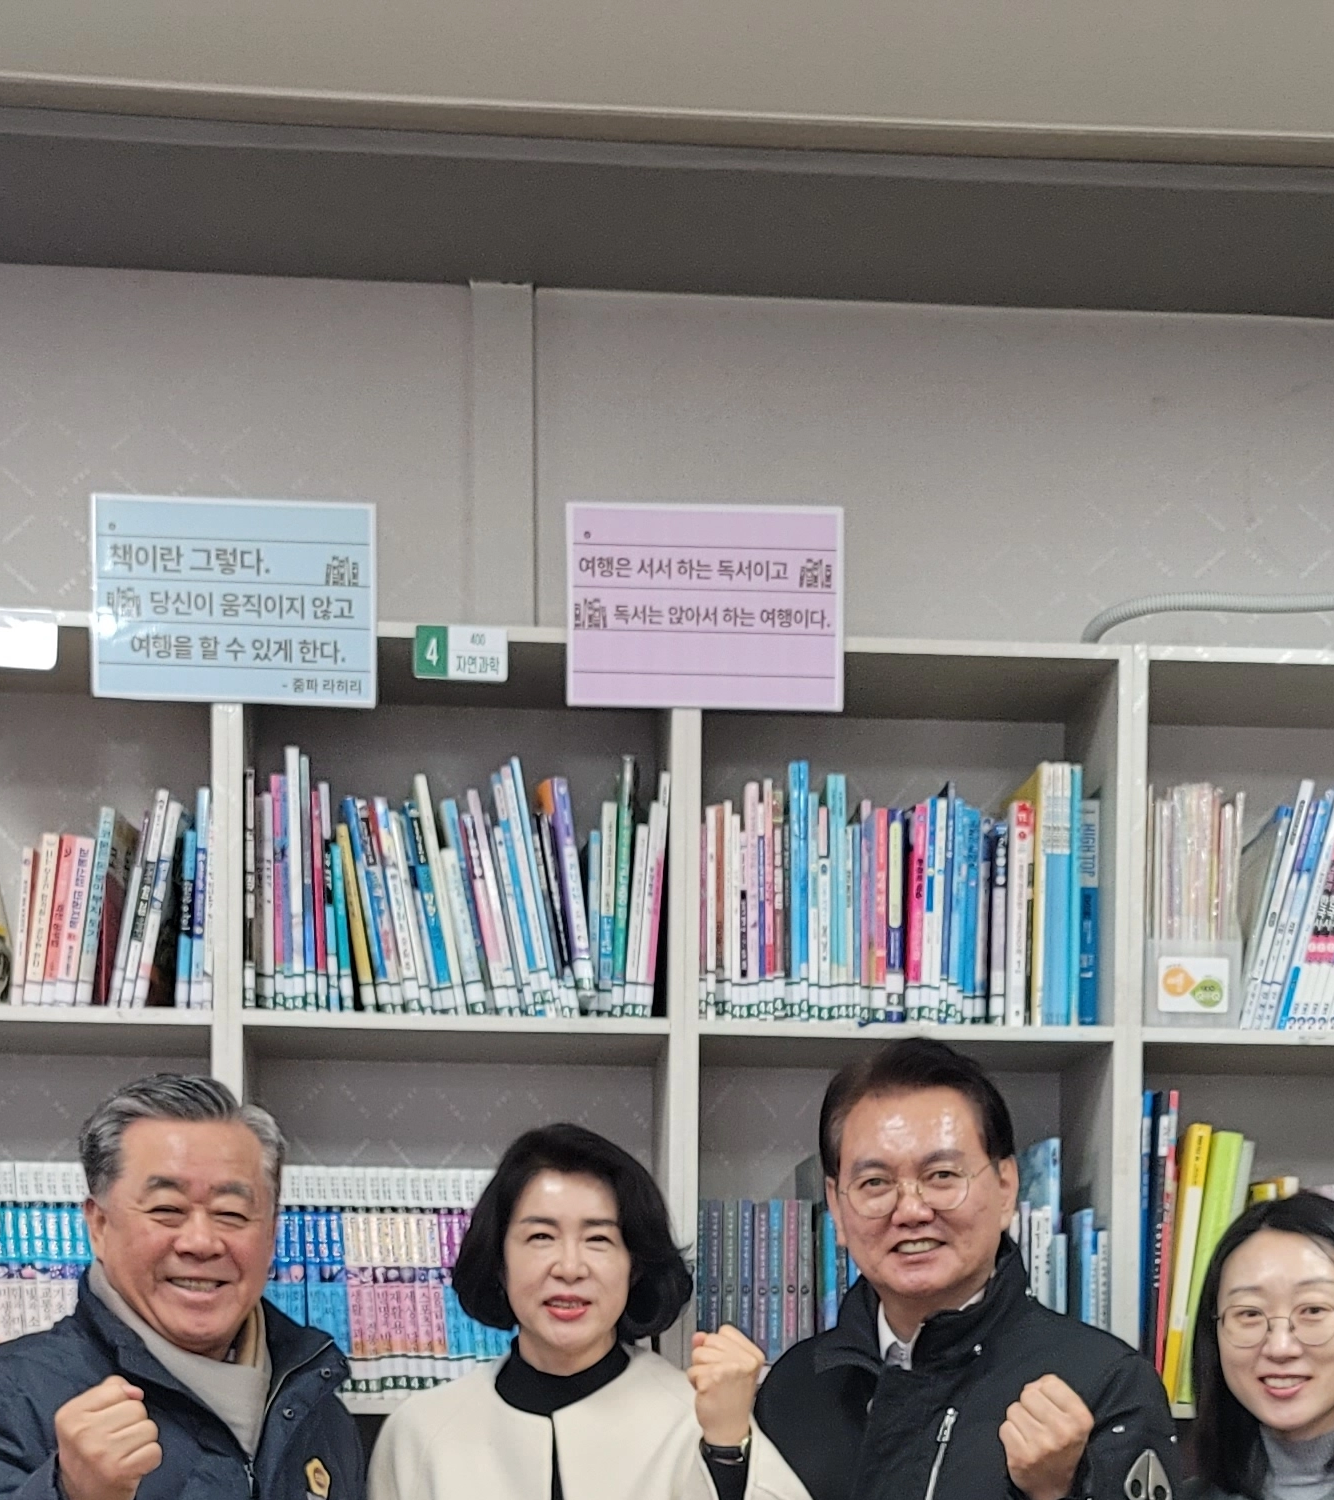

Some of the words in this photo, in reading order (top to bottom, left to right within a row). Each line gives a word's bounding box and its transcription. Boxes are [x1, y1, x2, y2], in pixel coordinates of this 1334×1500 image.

[109, 543, 186, 576] 책이란
[189, 545, 271, 577] 그렇다.
[578, 556, 632, 579] 여행은
[637, 558, 671, 579] 서서
[676, 559, 712, 580] 하는
[717, 559, 788, 582] 독서이고
[149, 589, 214, 617] 당신이
[219, 591, 306, 620] 움직이지
[310, 594, 355, 621] 않고
[613, 604, 665, 626] 독서는
[668, 606, 719, 628] 앉아서
[722, 607, 757, 628] 하는
[761, 607, 831, 630] 여행이다.
[130, 634, 194, 661] 여행을
[199, 634, 220, 662] 할
[224, 636, 246, 660] 수
[251, 637, 294, 664] 있게
[298, 639, 347, 665] 한다.
[425, 636, 439, 667] 4
[456, 654, 500, 676] 자연과학
